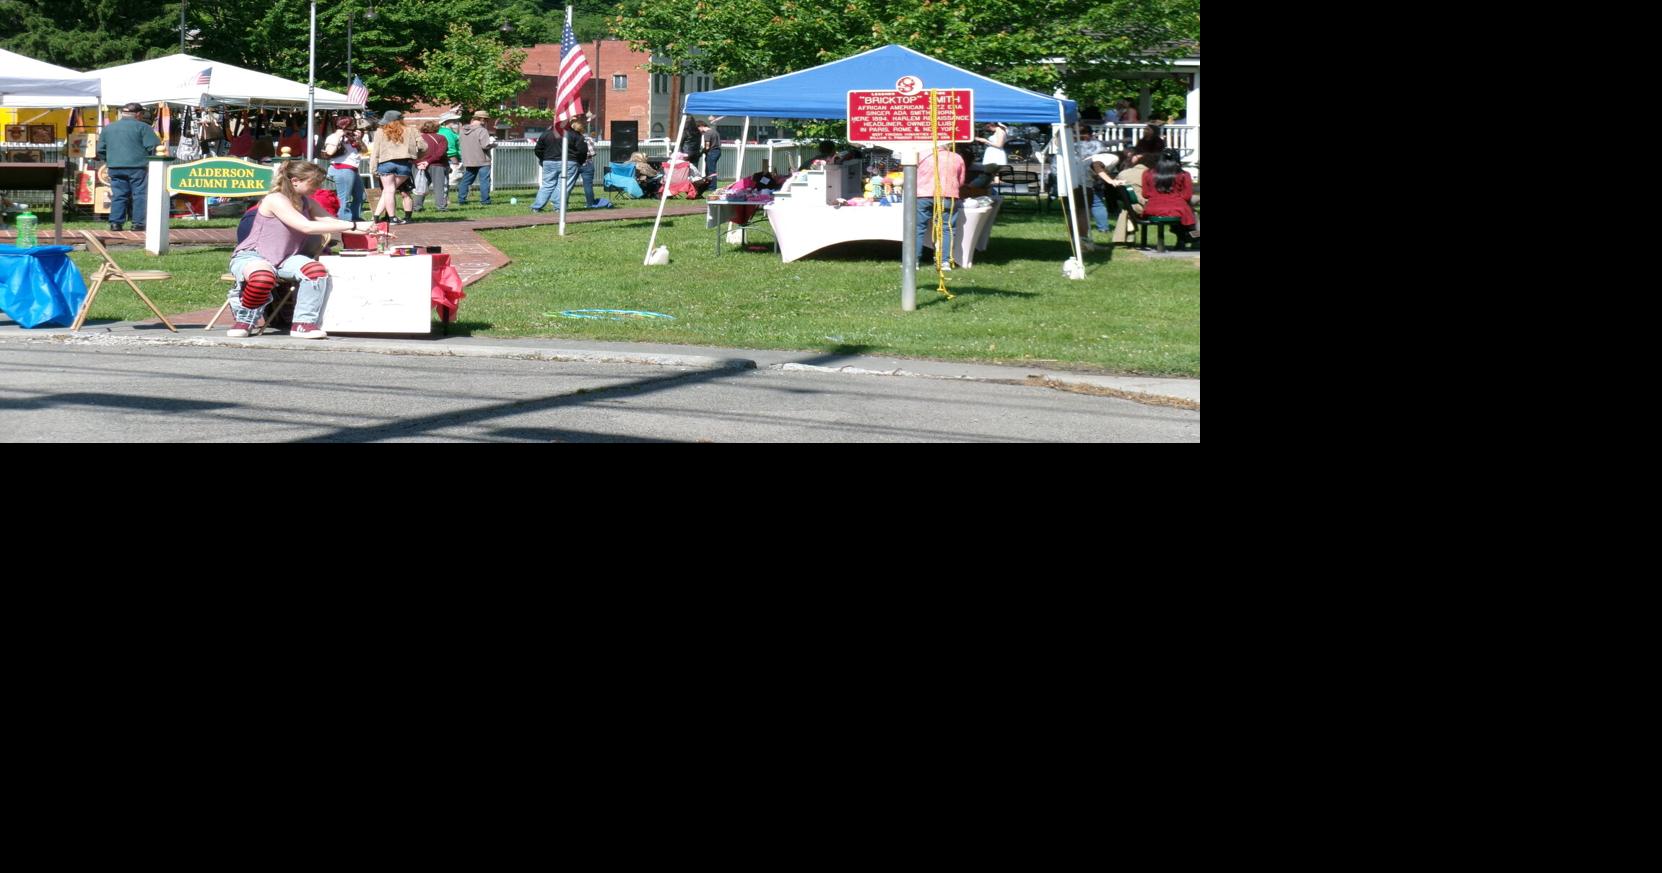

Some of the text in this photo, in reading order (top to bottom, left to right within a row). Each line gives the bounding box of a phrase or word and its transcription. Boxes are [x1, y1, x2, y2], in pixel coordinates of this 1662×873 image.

[859, 96, 922, 104] "BRICKTOP"
[189, 168, 254, 178] ALDERSON
[179, 178, 264, 188] ALUMNI PARK
